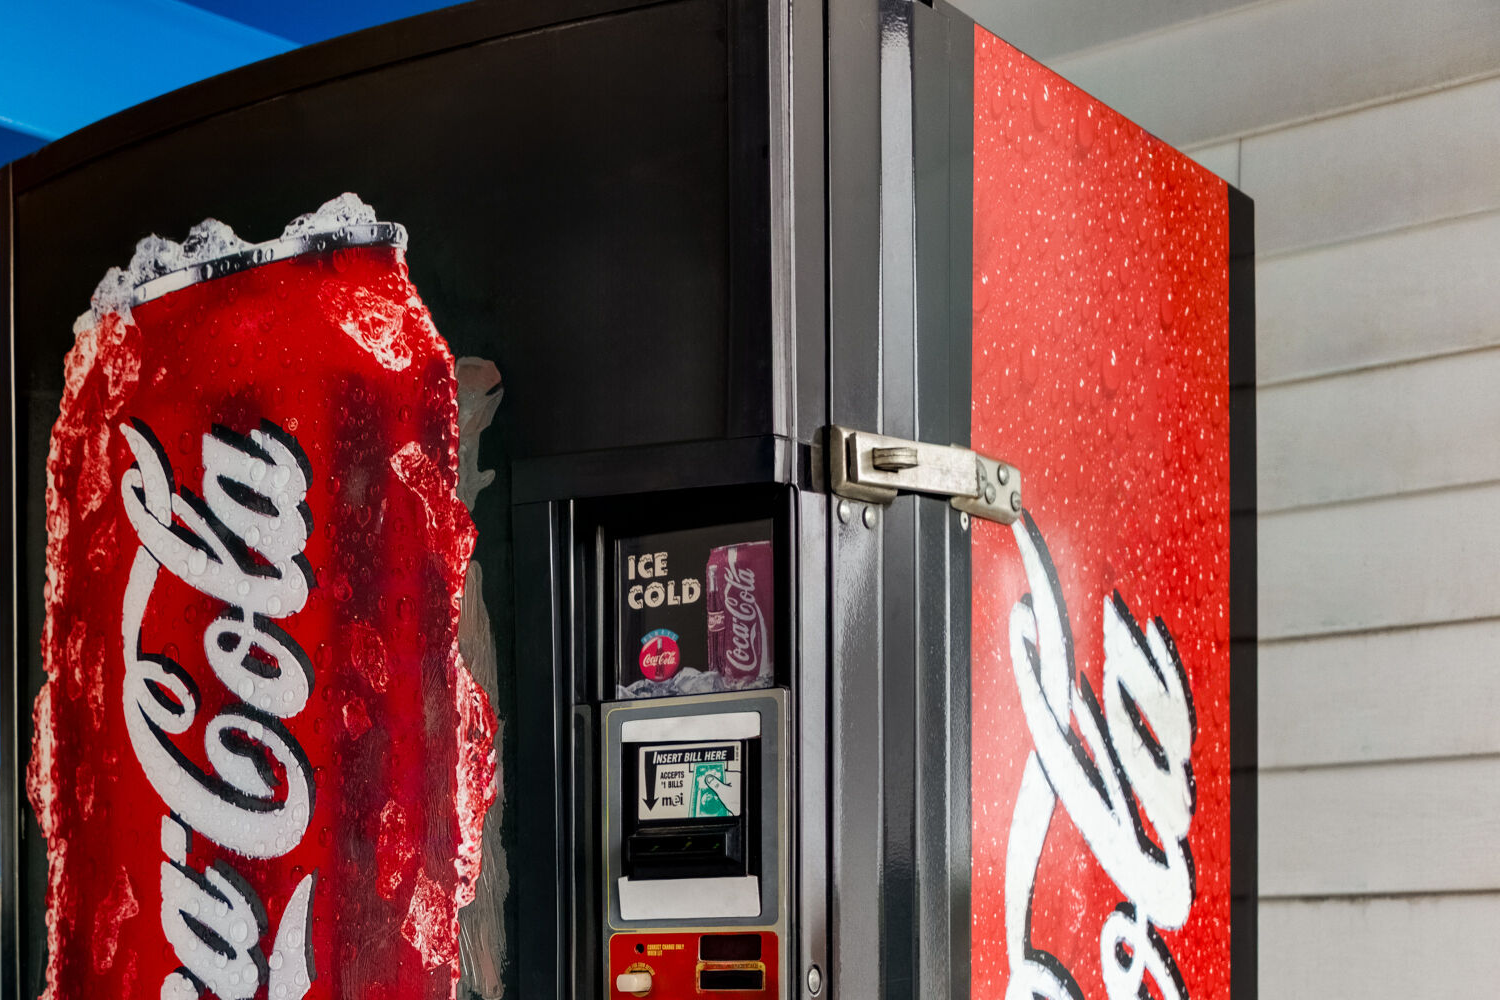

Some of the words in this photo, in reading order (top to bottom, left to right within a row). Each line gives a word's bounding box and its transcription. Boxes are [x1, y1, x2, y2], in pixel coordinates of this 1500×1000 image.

[627, 552, 668, 580] ICE
[627, 578, 701, 610] COLD
[724, 565, 757, 672] Coca-Cola
[684, 752, 702, 762] BILL
[704, 750, 727, 761] HERE
[660, 771, 685, 780] ACCEPTS
[668, 780, 683, 789] BILLS
